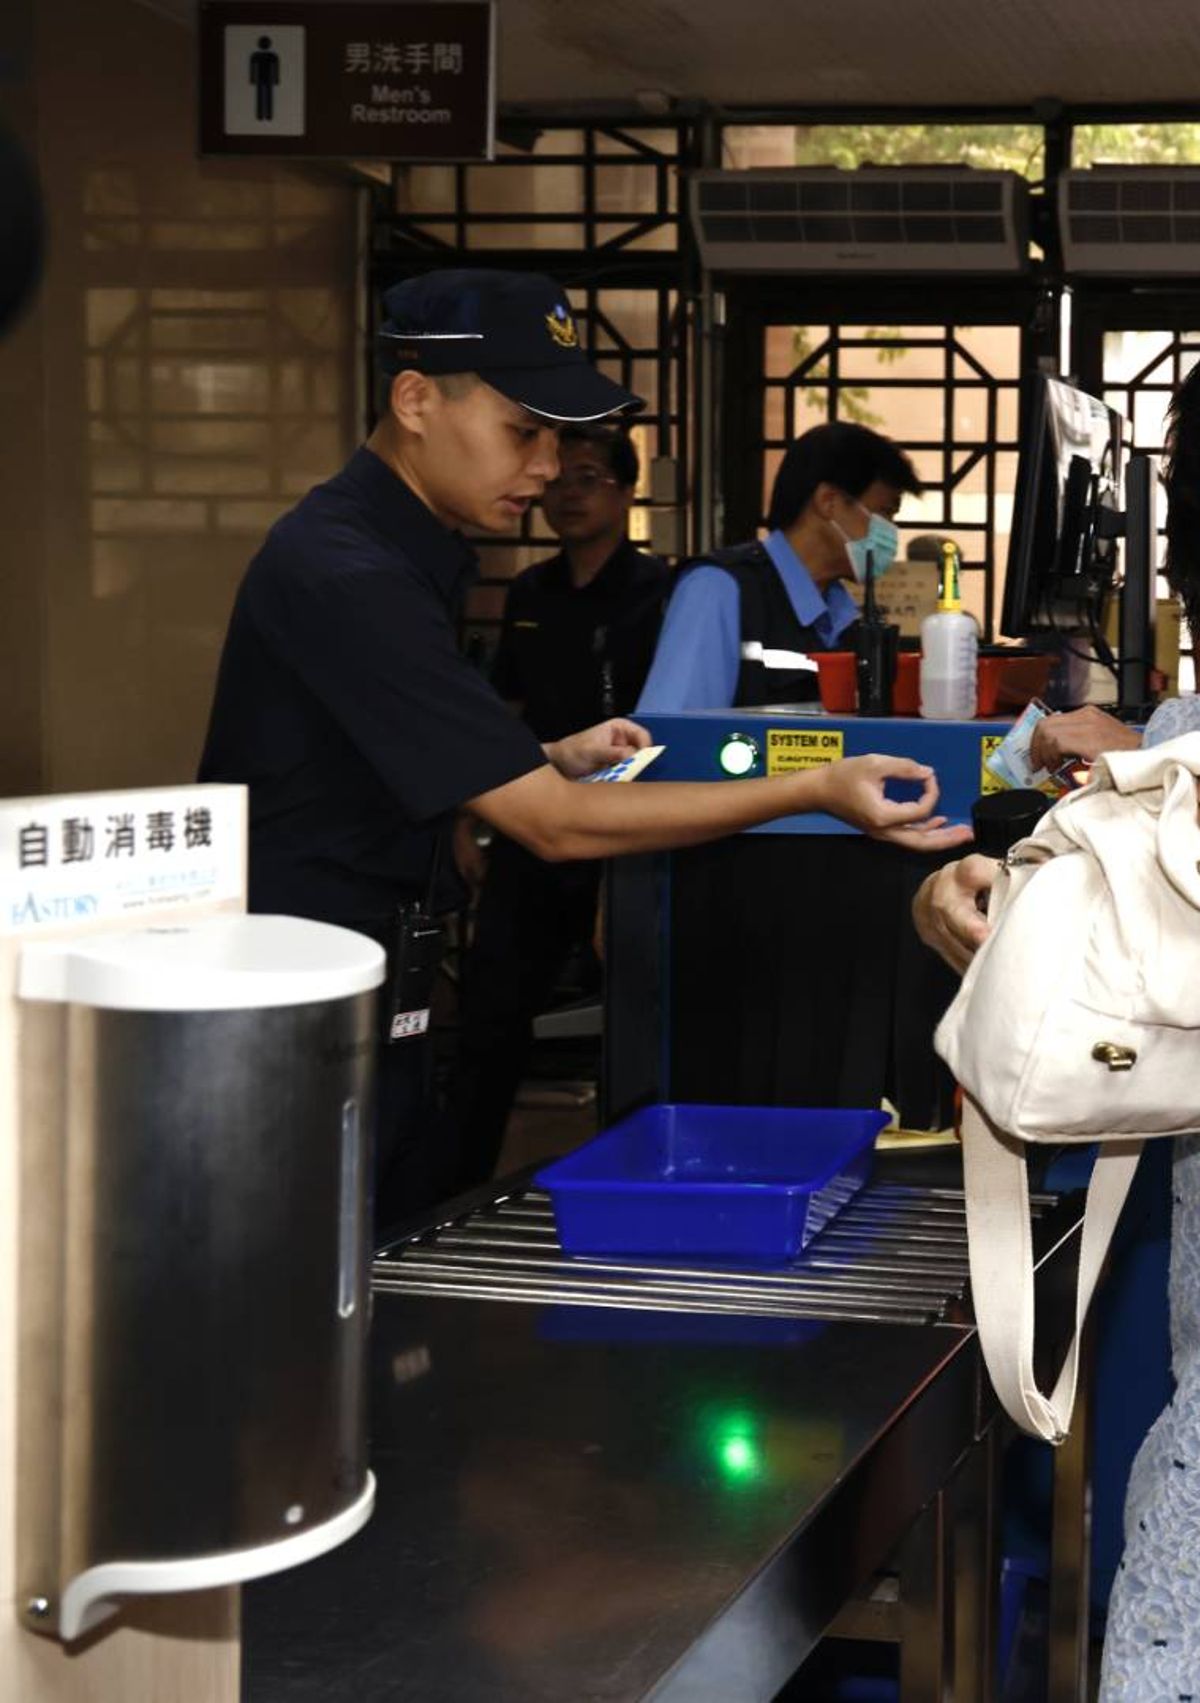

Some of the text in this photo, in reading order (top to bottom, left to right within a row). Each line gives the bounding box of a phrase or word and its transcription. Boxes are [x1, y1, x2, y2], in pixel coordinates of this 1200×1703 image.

[345, 43, 463, 75] 男洗手間
[371, 84, 431, 103] Men's
[352, 103, 451, 123] Restroom
[770, 733, 839, 748] SYSTEM ON
[777, 755, 832, 764] CAUTION
[18, 806, 212, 869] 自動消毒機
